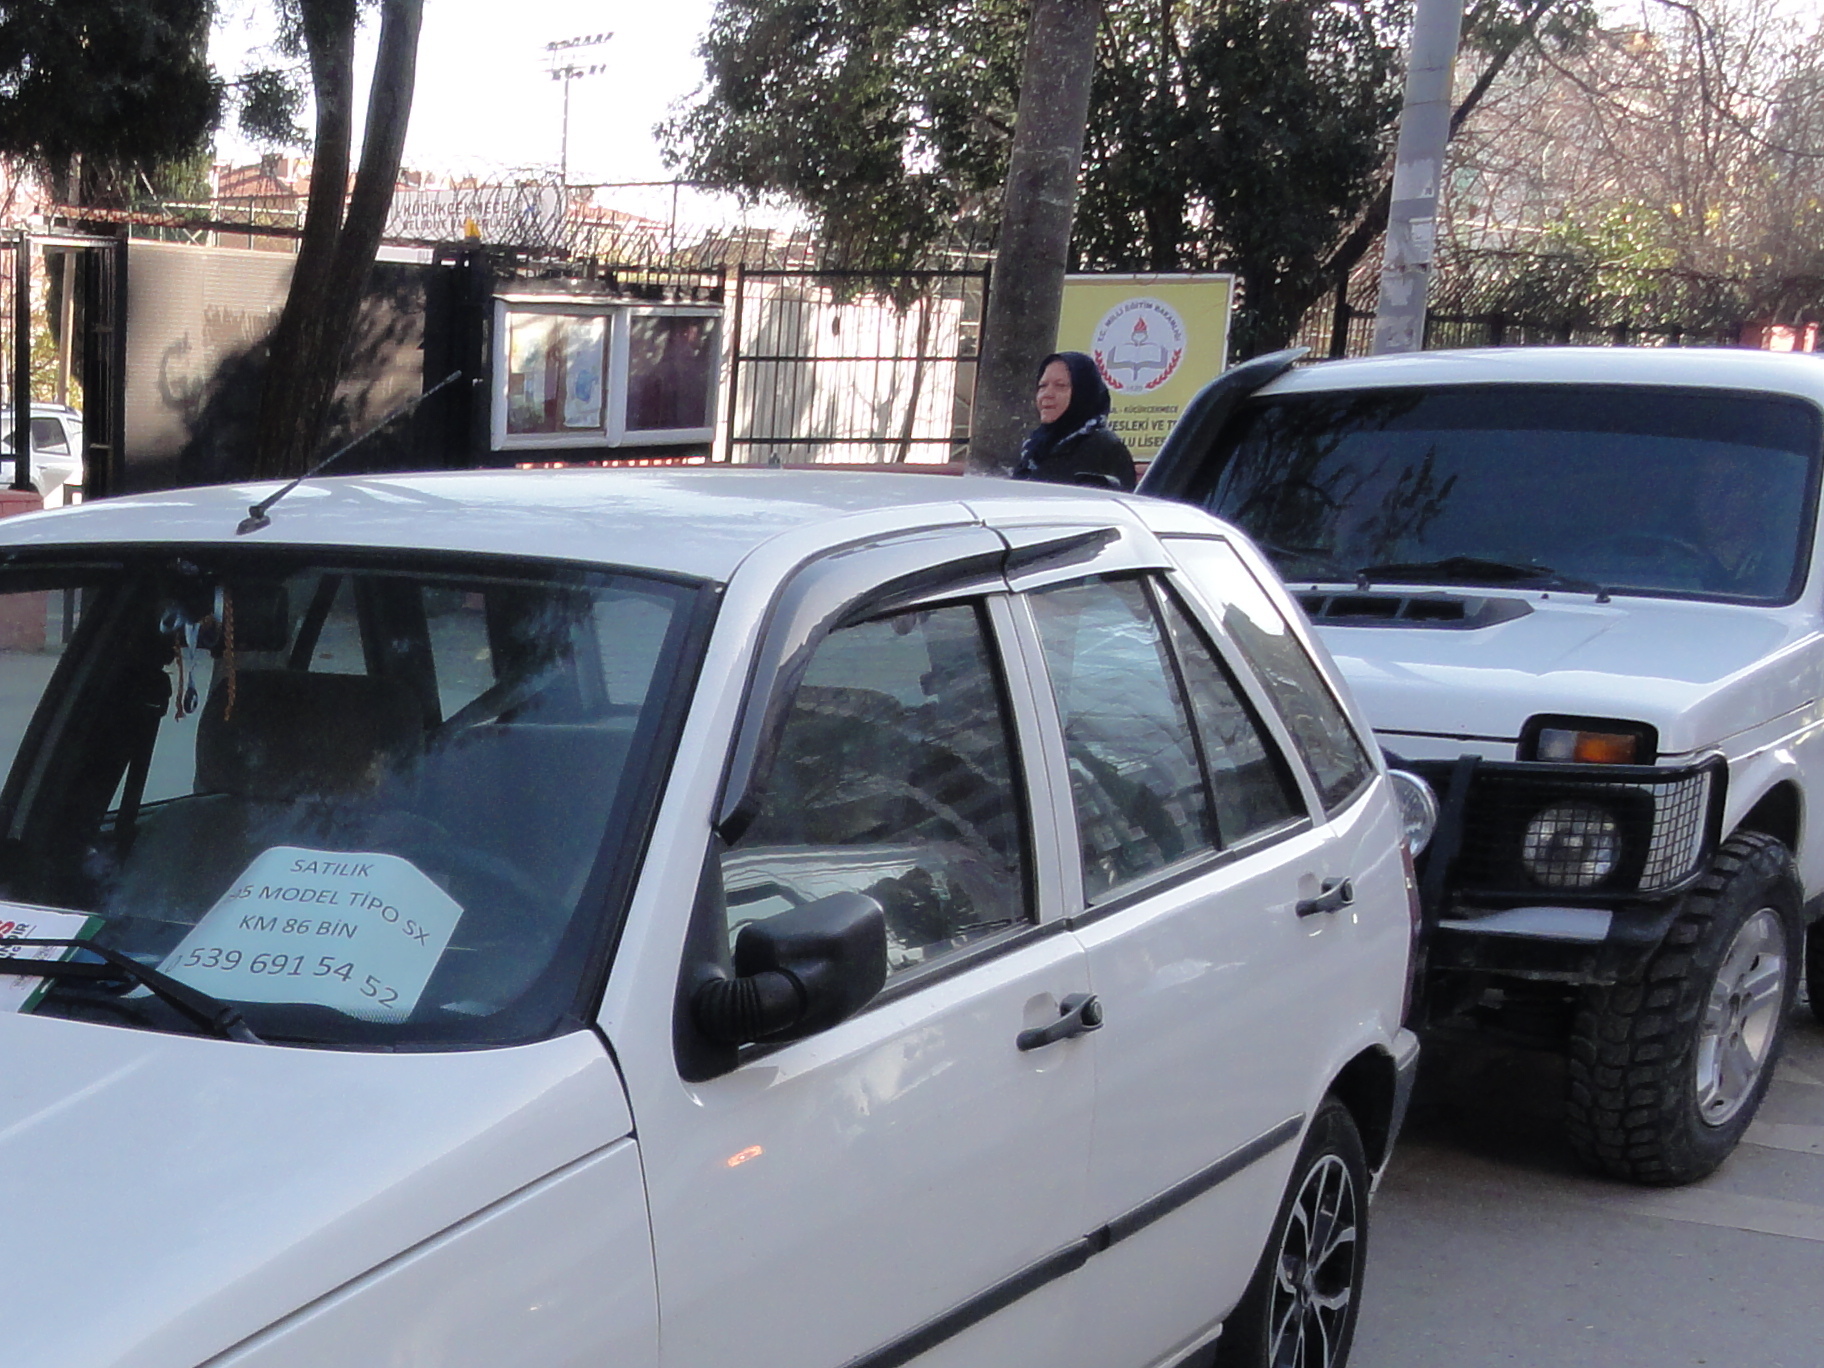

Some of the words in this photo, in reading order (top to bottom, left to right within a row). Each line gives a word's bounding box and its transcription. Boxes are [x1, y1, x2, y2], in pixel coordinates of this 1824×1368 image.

[1151, 419, 1163, 431] VE
[290, 859, 375, 878] SATILIK
[239, 914, 278, 933] KM
[282, 918, 312, 935] 86
[316, 918, 358, 939] BİN
[259, 885, 339, 905] MODEL
[349, 890, 400, 923] TİPO
[402, 918, 431, 947] SX
[250, 952, 305, 977] 691
[313, 956, 354, 982] 54
[359, 974, 400, 1009] 52
